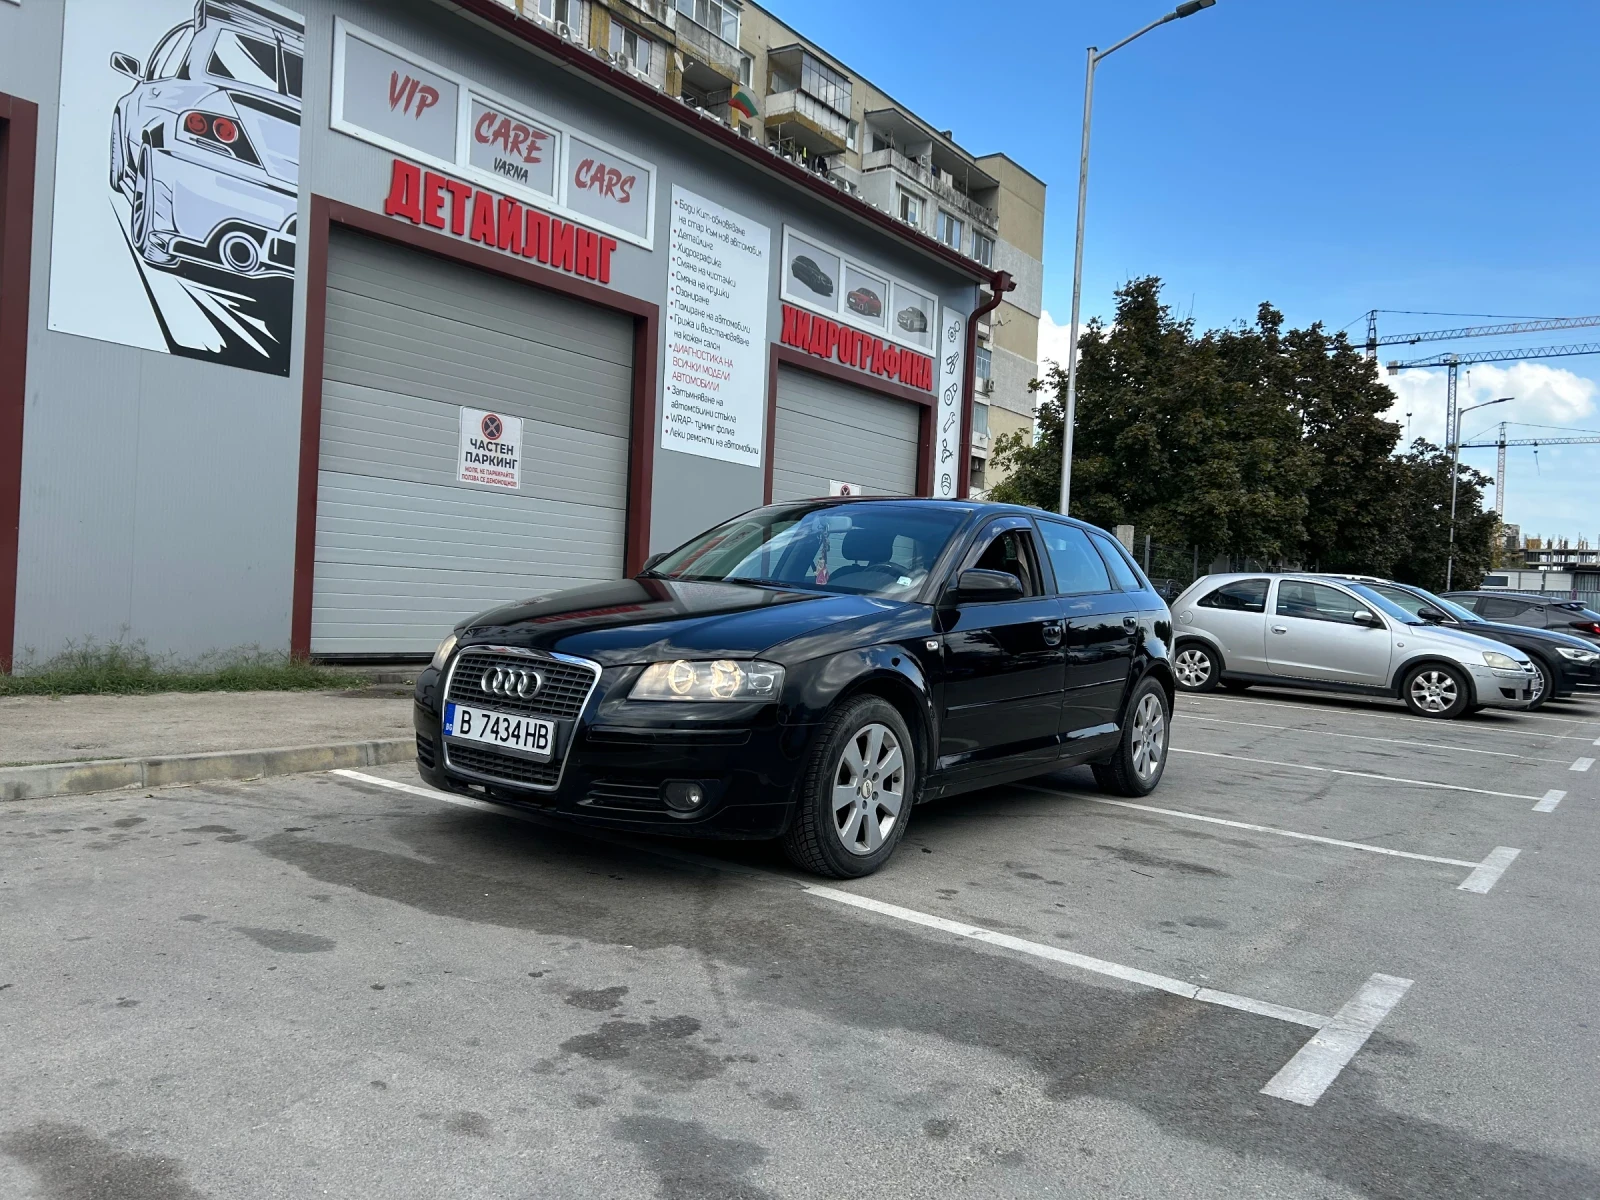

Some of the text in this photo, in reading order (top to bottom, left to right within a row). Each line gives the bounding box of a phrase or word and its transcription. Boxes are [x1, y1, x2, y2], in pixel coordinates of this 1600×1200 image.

[389, 70, 637, 204] VIP CARE CARS
[494, 157, 529, 183] VARNA
[679, 198, 696, 215] Боди
[385, 159, 617, 284] ДЕТАЙЛИНГ
[678, 227, 713, 250] Детайлинг
[679, 215, 762, 257] на стар към нов автомобил
[678, 241, 721, 268] Хидрографика
[676, 270, 730, 299] Смяна на крушки
[677, 256, 736, 288] Смяна на чистачки
[676, 284, 710, 305] Озониране
[675, 298, 751, 334] Полиране на автомобили
[674, 313, 695, 329] Грижа
[701, 322, 749, 346] възстановяване
[674, 330, 721, 351] на кожен салон
[673, 342, 734, 369] ДИАГНОСТИКА НА
[781, 304, 933, 392] ХИДРОГРАФИКА
[673, 355, 730, 381] ВСИЧКИ МОДЕЛИ
[672, 371, 719, 392] АВТОМОБИЛИ
[672, 384, 724, 407] Затъмняване на
[671, 399, 737, 423] автомобилни стъкла
[470, 438, 514, 455] ЧАСТЕН
[669, 426, 759, 455] Леки ремонти на автомобили
[465, 451, 518, 469] ПАРКИНГ
[445, 723, 453, 732] BG
[460, 710, 473, 735] B
[479, 713, 521, 745] 7434
